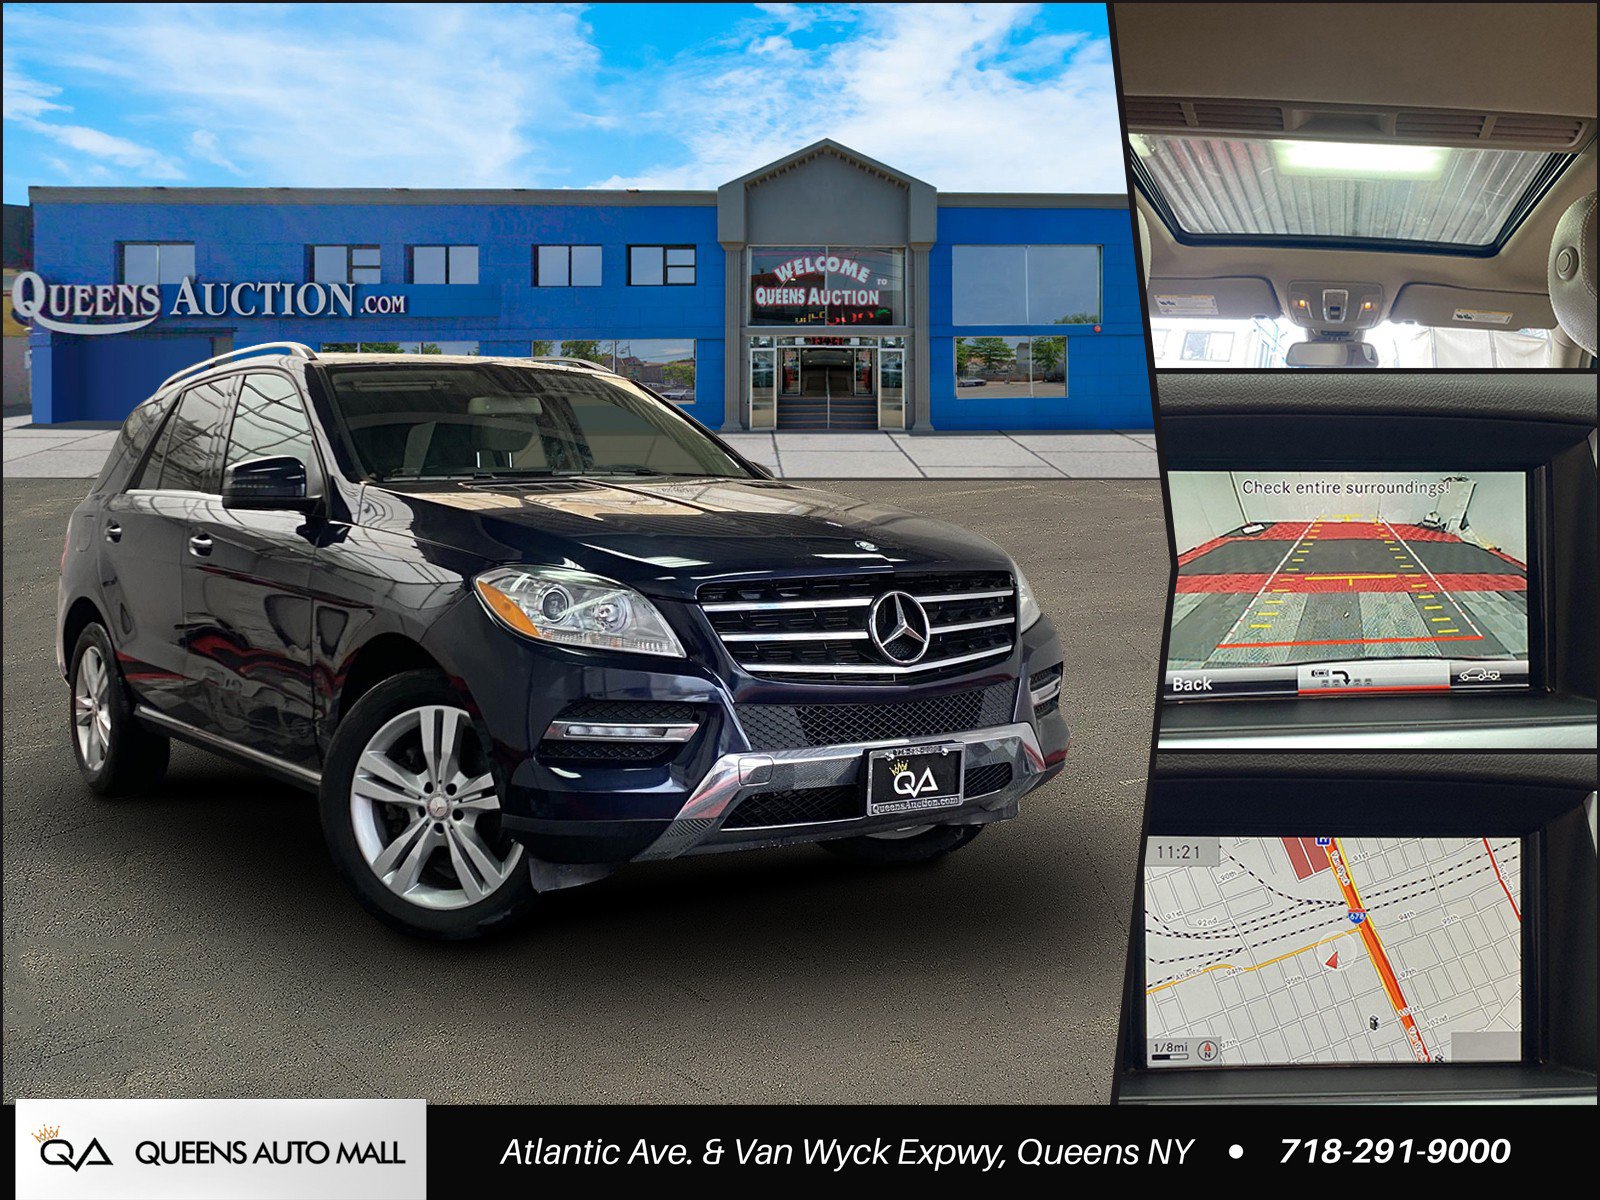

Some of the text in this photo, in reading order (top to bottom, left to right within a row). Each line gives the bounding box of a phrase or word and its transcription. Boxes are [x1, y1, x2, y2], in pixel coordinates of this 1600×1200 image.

[773, 256, 871, 284] WELCOME
[11, 271, 162, 335] QUEENS
[170, 276, 356, 317] AUCTION
[755, 287, 880, 306] QUEENS AUCTION
[1242, 479, 1450, 497] Check entire surroundings!
[1173, 677, 1213, 692] Back
[894, 767, 939, 797] QA
[1158, 845, 1200, 859] 11:21
[1197, 917, 1218, 927] 92nd
[1154, 1042, 1188, 1053] 1/8mi
